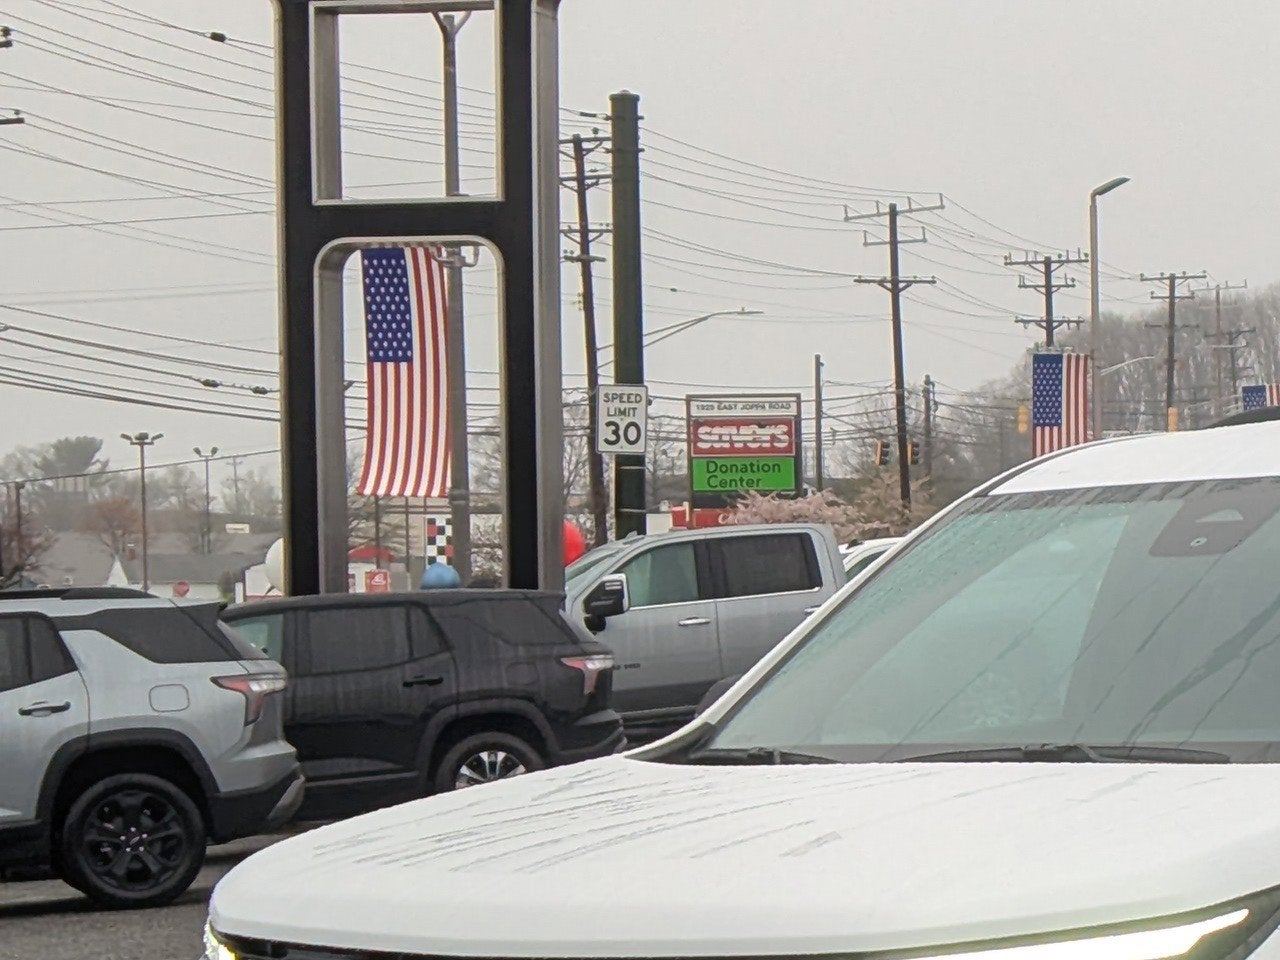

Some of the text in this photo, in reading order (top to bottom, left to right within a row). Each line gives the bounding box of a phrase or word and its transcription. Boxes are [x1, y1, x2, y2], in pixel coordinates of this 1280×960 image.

[603, 392, 642, 404] SPEED
[606, 406, 638, 417] LIMIT
[717, 403, 737, 411] EAST
[768, 402, 791, 410] ROAD
[603, 420, 642, 446] 30
[706, 460, 781, 475] Donation
[707, 475, 763, 489] Center
